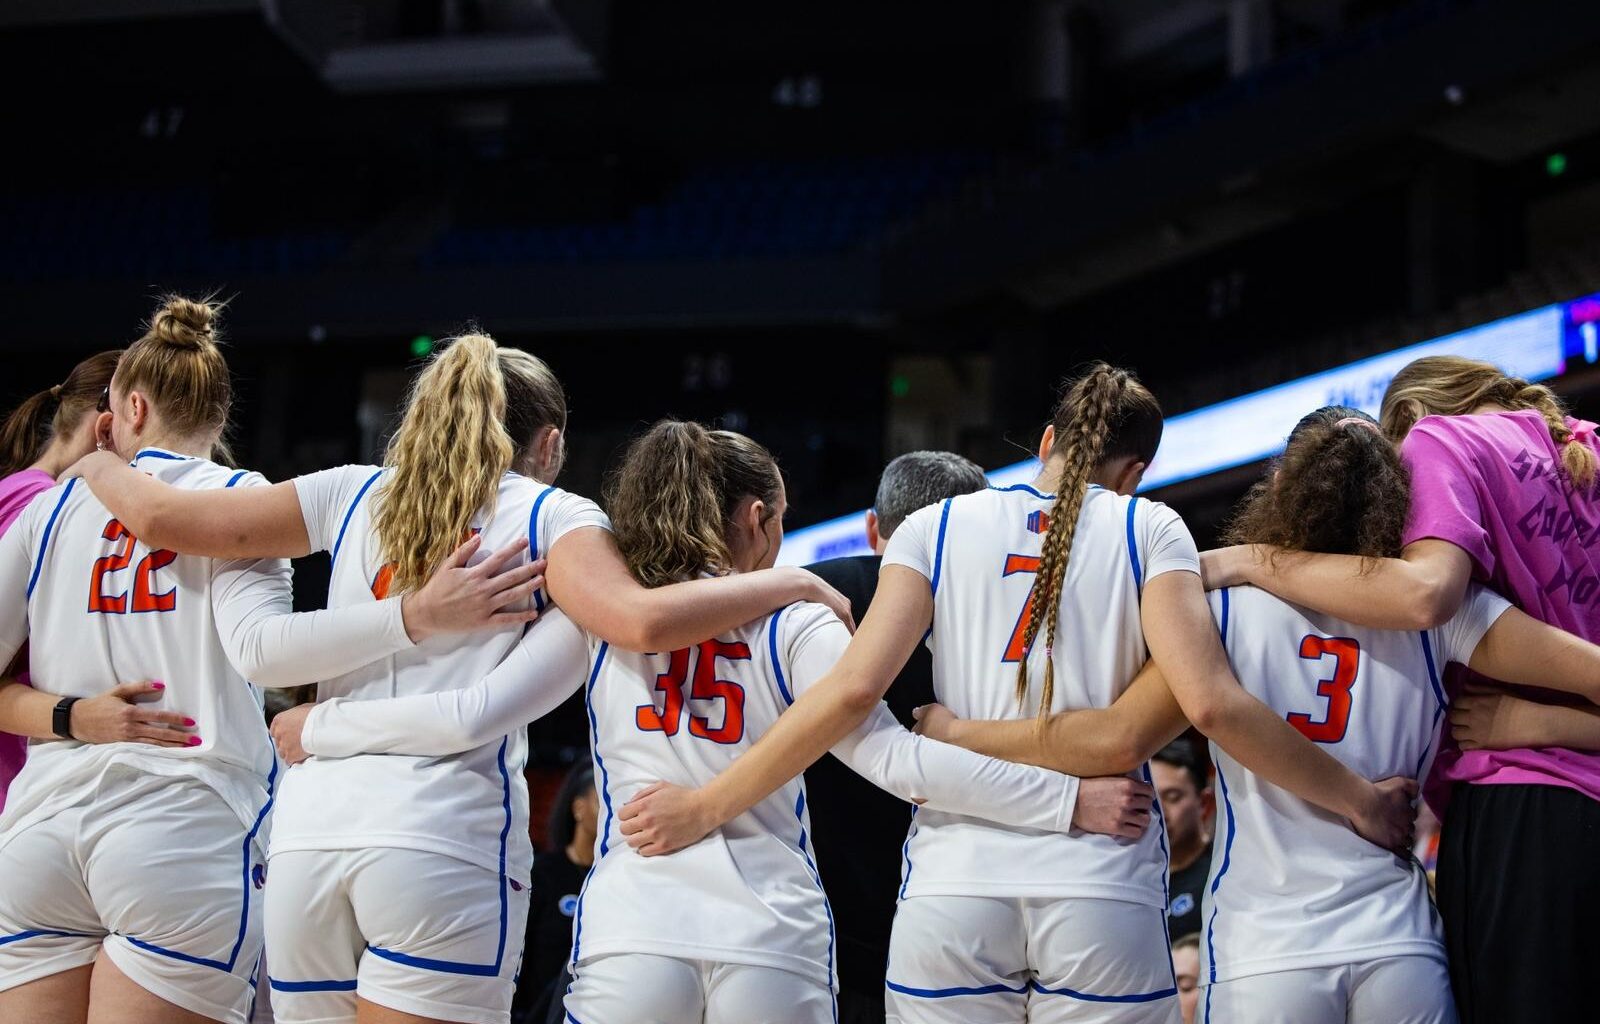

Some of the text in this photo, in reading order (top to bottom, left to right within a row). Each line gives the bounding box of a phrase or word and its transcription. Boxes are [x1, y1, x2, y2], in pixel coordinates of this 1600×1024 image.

[88, 518, 178, 614] 22
[1001, 553, 1056, 662] 7
[636, 638, 752, 744] 35
[1286, 634, 1360, 743] 3
